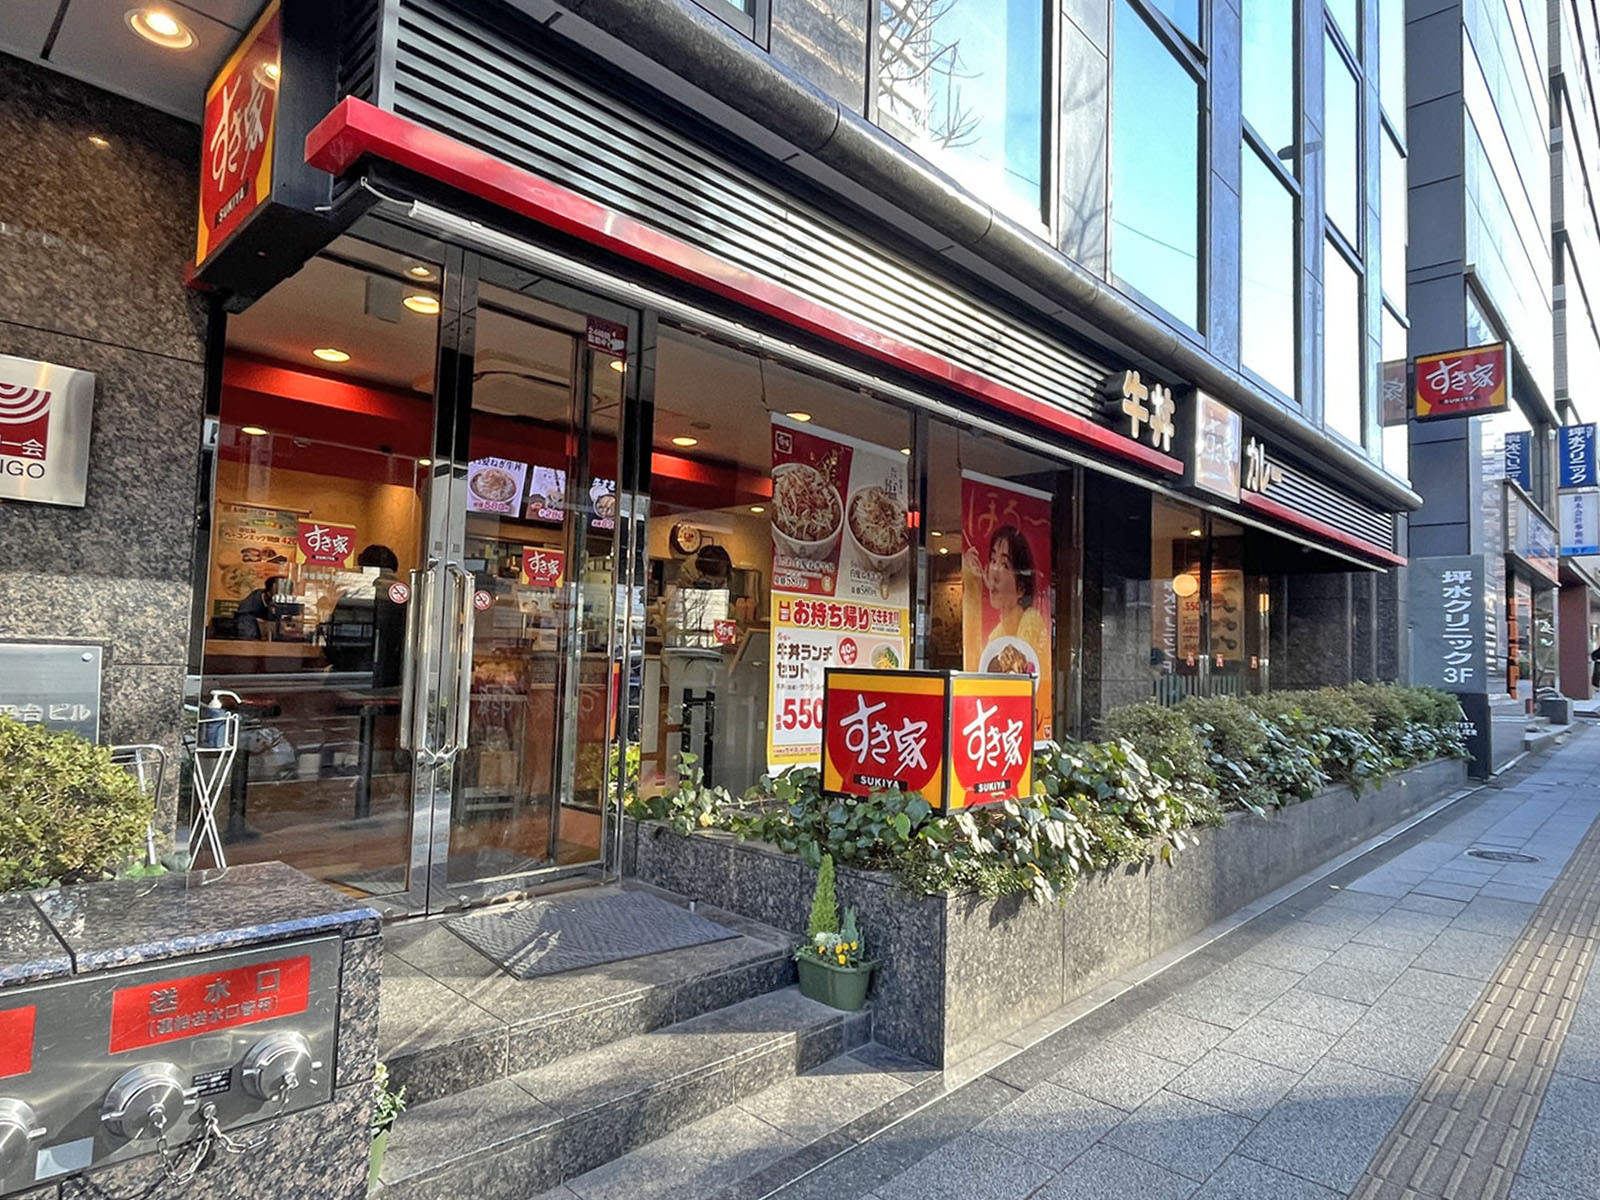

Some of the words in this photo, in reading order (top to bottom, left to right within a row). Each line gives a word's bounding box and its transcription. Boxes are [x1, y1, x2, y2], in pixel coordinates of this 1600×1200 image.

[209, 75, 266, 192] すき家
[1425, 360, 1495, 395] すき家
[1122, 369, 1176, 452] 牛丼
[0, 434, 44, 457] 一会
[1568, 427, 1588, 484] 坪水クリニック
[1247, 436, 1283, 492] カレー
[304, 524, 349, 556] すき家
[528, 551, 560, 577] すき家
[1442, 570, 1473, 665] 坪水クリニック
[776, 643, 833, 662] 牛丼ランチ
[776, 662, 809, 679] セット
[1443, 668, 1474, 684] 3F
[839, 693, 929, 777] すき家
[962, 698, 1023, 777] すき家
[859, 775, 900, 790] SUKIYA
[977, 782, 1007, 793] SUKIYA
